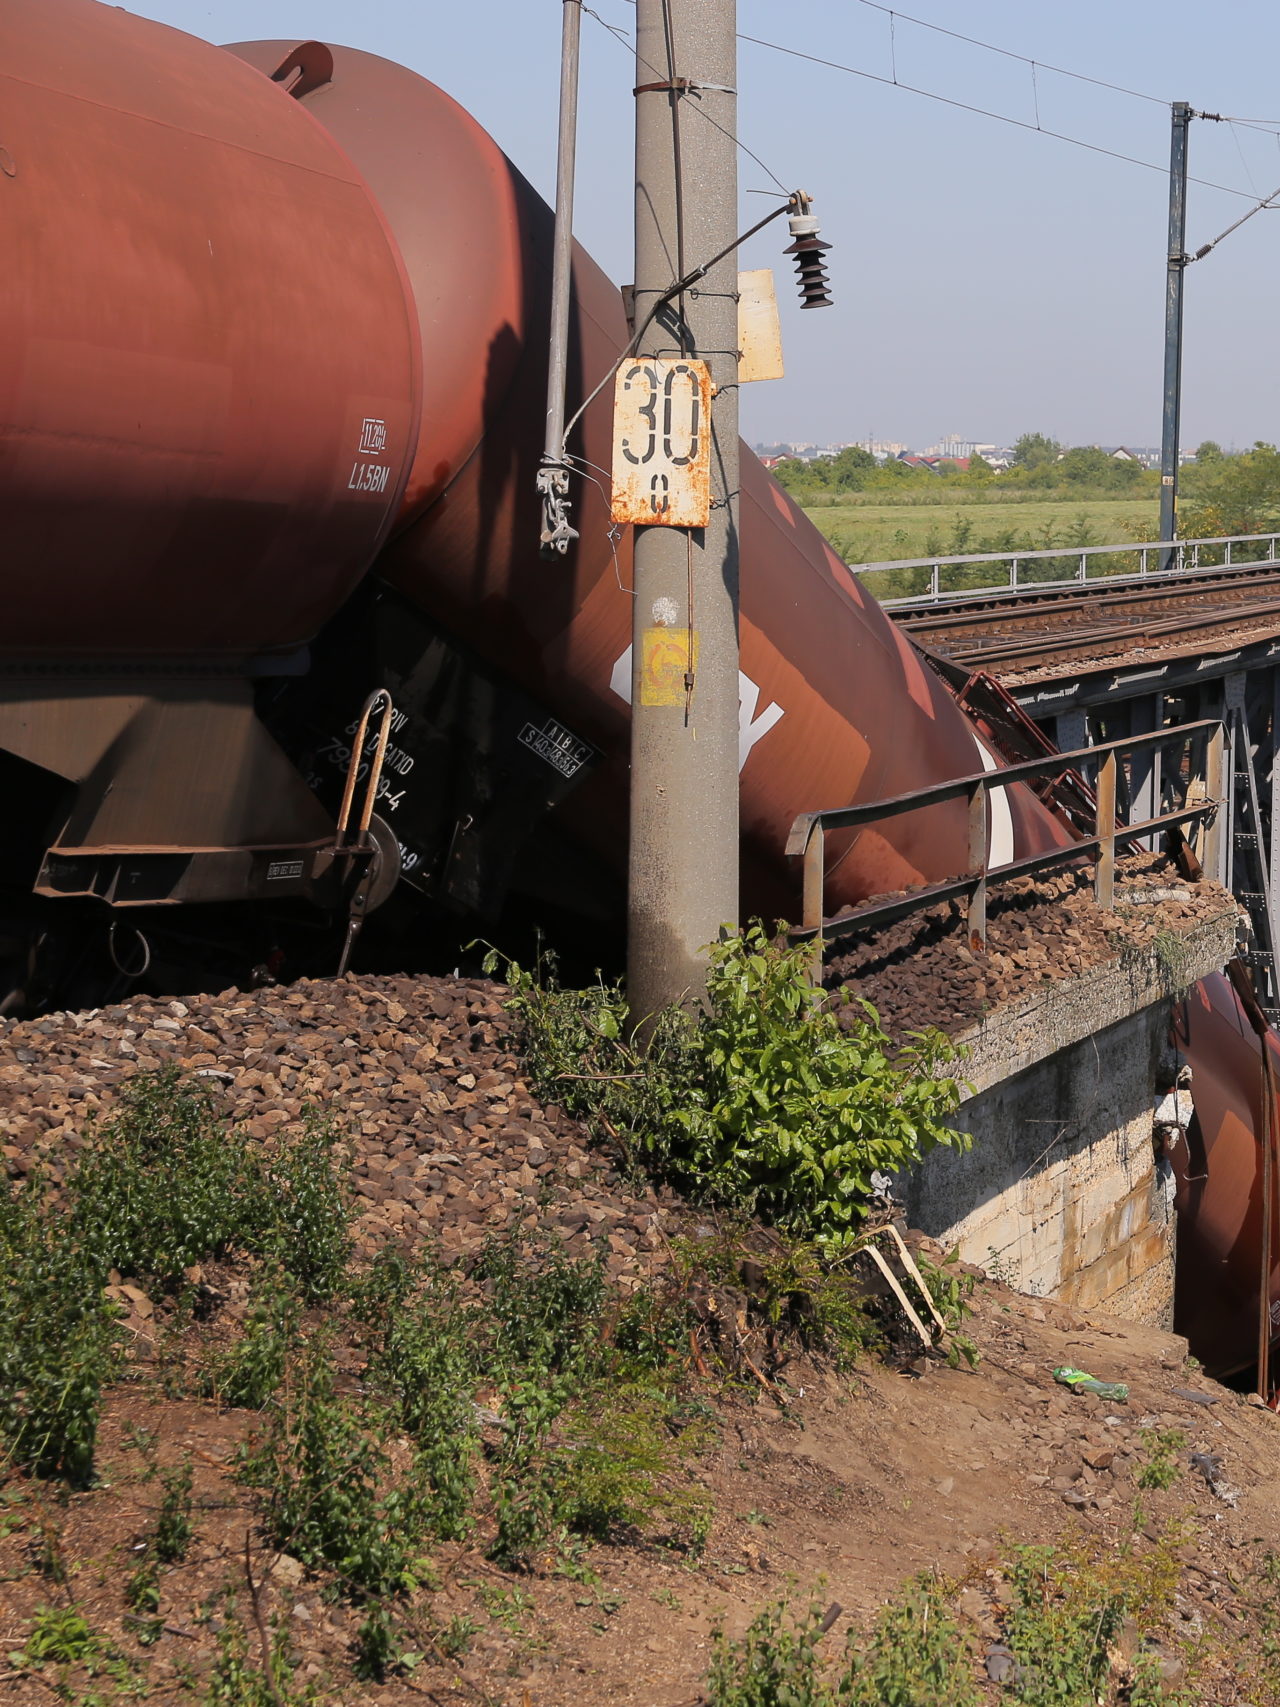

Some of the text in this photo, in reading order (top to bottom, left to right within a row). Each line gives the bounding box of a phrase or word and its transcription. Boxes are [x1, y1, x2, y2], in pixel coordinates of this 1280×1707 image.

[622, 364, 699, 466] 30
[525, 729, 536, 743] S
[547, 725, 586, 759] A B C
